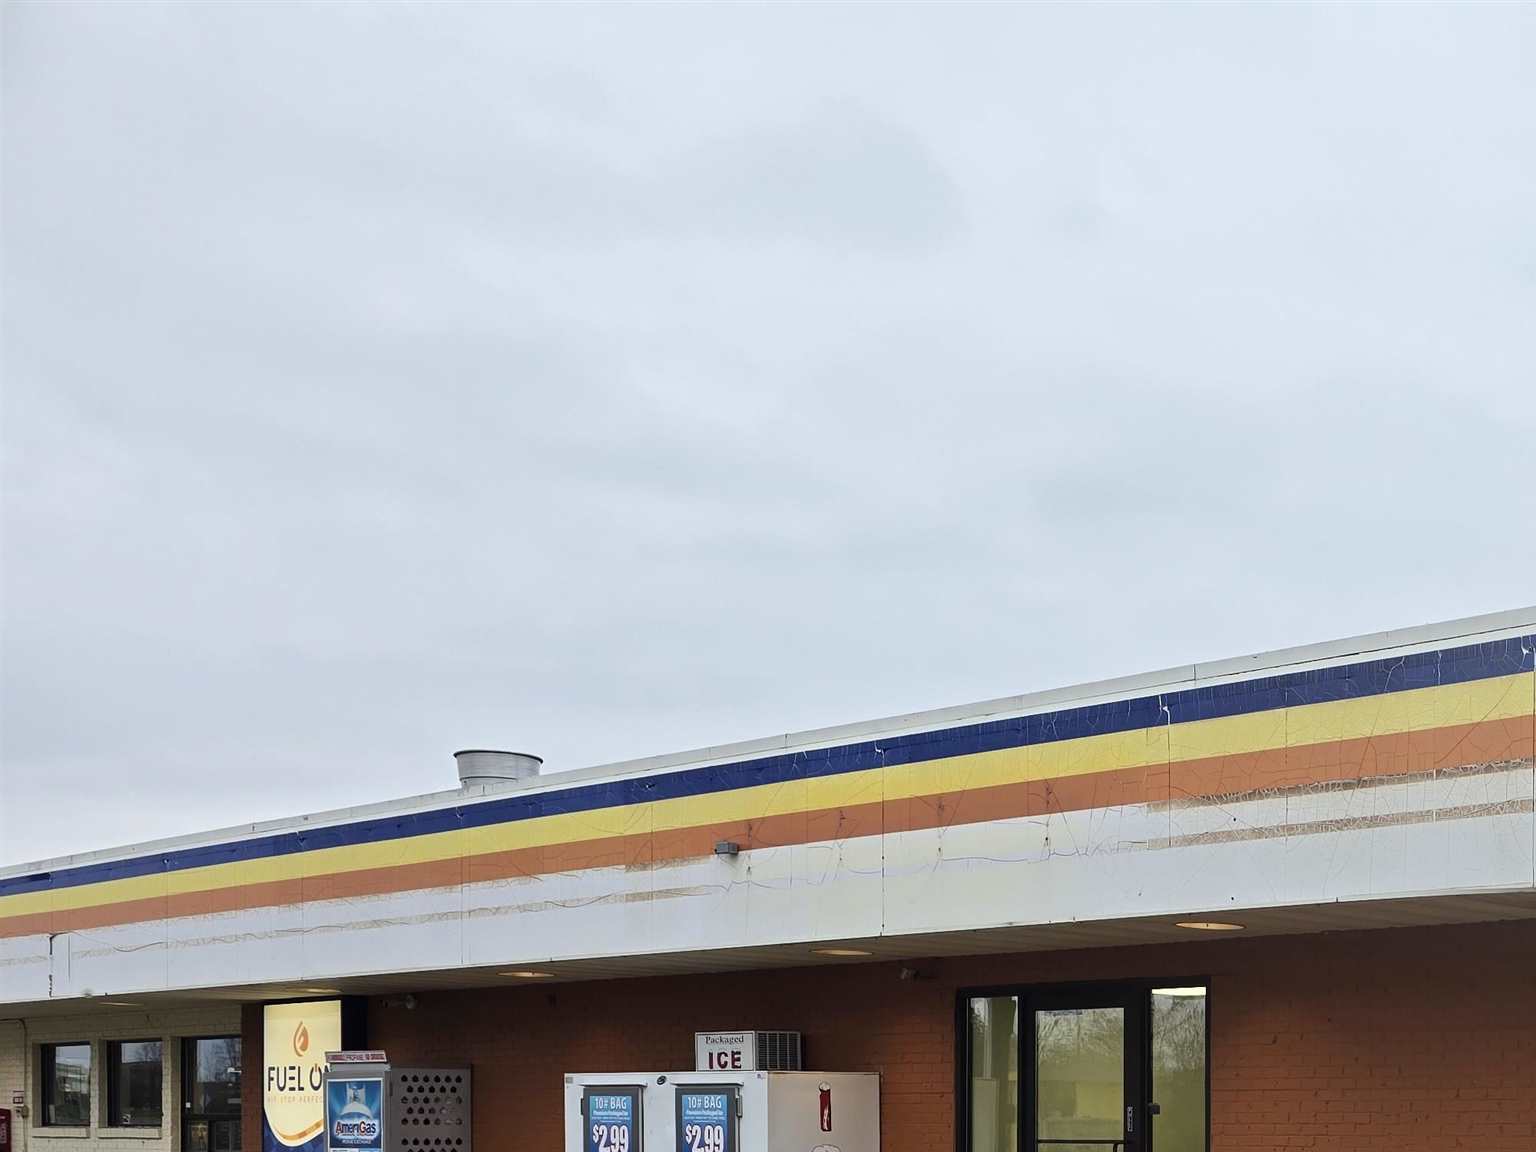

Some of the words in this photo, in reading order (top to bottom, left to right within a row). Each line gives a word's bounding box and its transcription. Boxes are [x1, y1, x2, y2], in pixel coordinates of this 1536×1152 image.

[705, 1035, 744, 1045] Packaged
[708, 1050, 742, 1070] ICE
[268, 1065, 305, 1092] FUEL
[610, 1096, 627, 1110] BAG
[704, 1095, 722, 1109] BAG
[335, 1120, 377, 1136] AmeriGas
